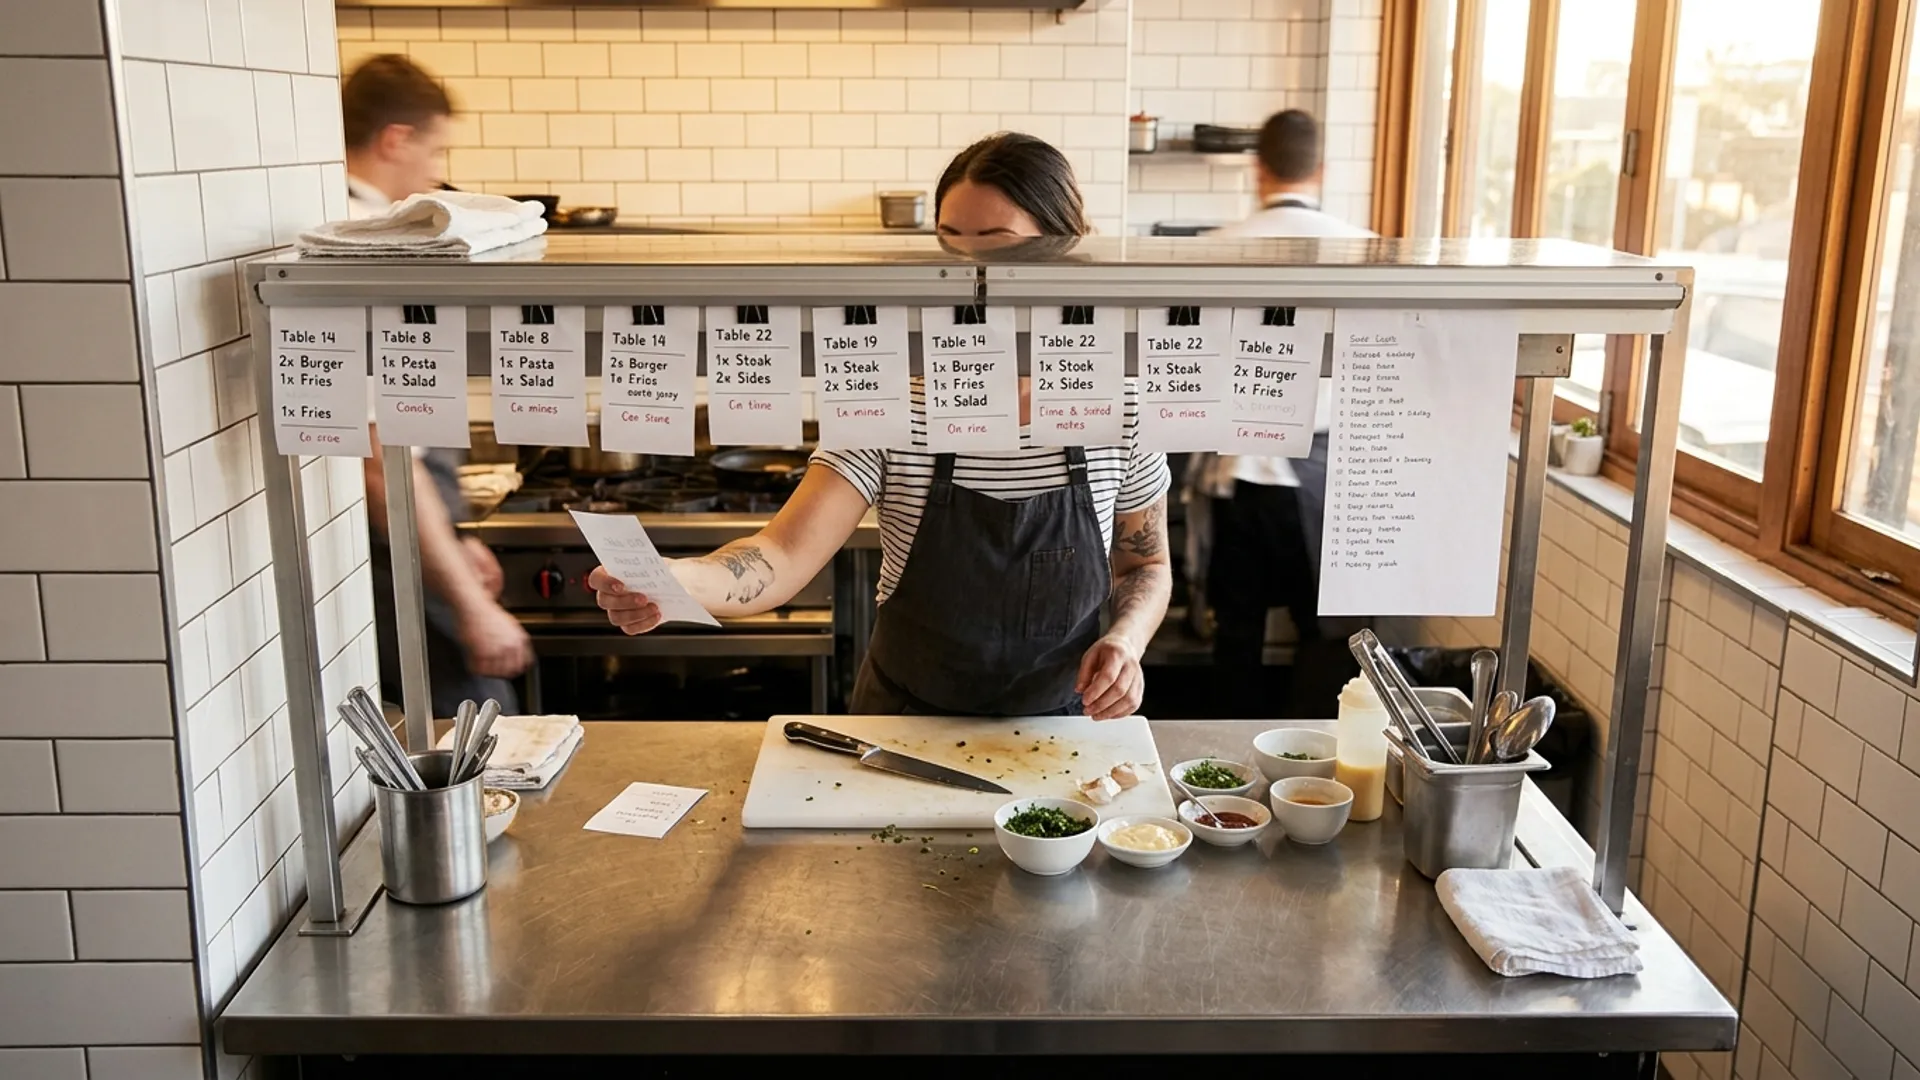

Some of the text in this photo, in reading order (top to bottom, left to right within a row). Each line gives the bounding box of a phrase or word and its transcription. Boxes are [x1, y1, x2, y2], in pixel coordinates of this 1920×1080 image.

[280, 330, 336, 343] Table 14
[382, 331, 431, 343] Table 8
[500, 331, 549, 344] Table 8
[613, 332, 666, 347] Table 14
[716, 329, 772, 341] Table 22
[933, 335, 986, 348] Table 14
[1040, 335, 1095, 347] Table 22
[824, 336, 877, 349] Table 19
[1148, 338, 1203, 350] Table 22
[1240, 340, 1273, 354] Table
[279, 355, 344, 372] 2x Burger
[520, 356, 555, 370] Pasta
[716, 354, 729, 366] 1x
[1039, 361, 1052, 372] 1x
[824, 361, 879, 374] 1x Steak
[933, 360, 995, 375] 1x Burger
[1147, 362, 1201, 375] 1x Steak
[1234, 365, 1297, 383] 2x Burger
[280, 373, 333, 387] 1x Fries
[382, 374, 436, 387] 1x Salad
[500, 375, 554, 387] 1x Salad
[737, 372, 771, 384] Sides
[954, 378, 984, 389] Fries
[1039, 378, 1093, 390] 2x Sides
[825, 379, 879, 391] 2x Sides
[1147, 380, 1201, 392] 2x Sides
[1234, 383, 1283, 398] 1x Fries
[933, 396, 987, 408] 1x Salad
[281, 406, 332, 419] 1x Fries
[1070, 407, 1077, 416] &
